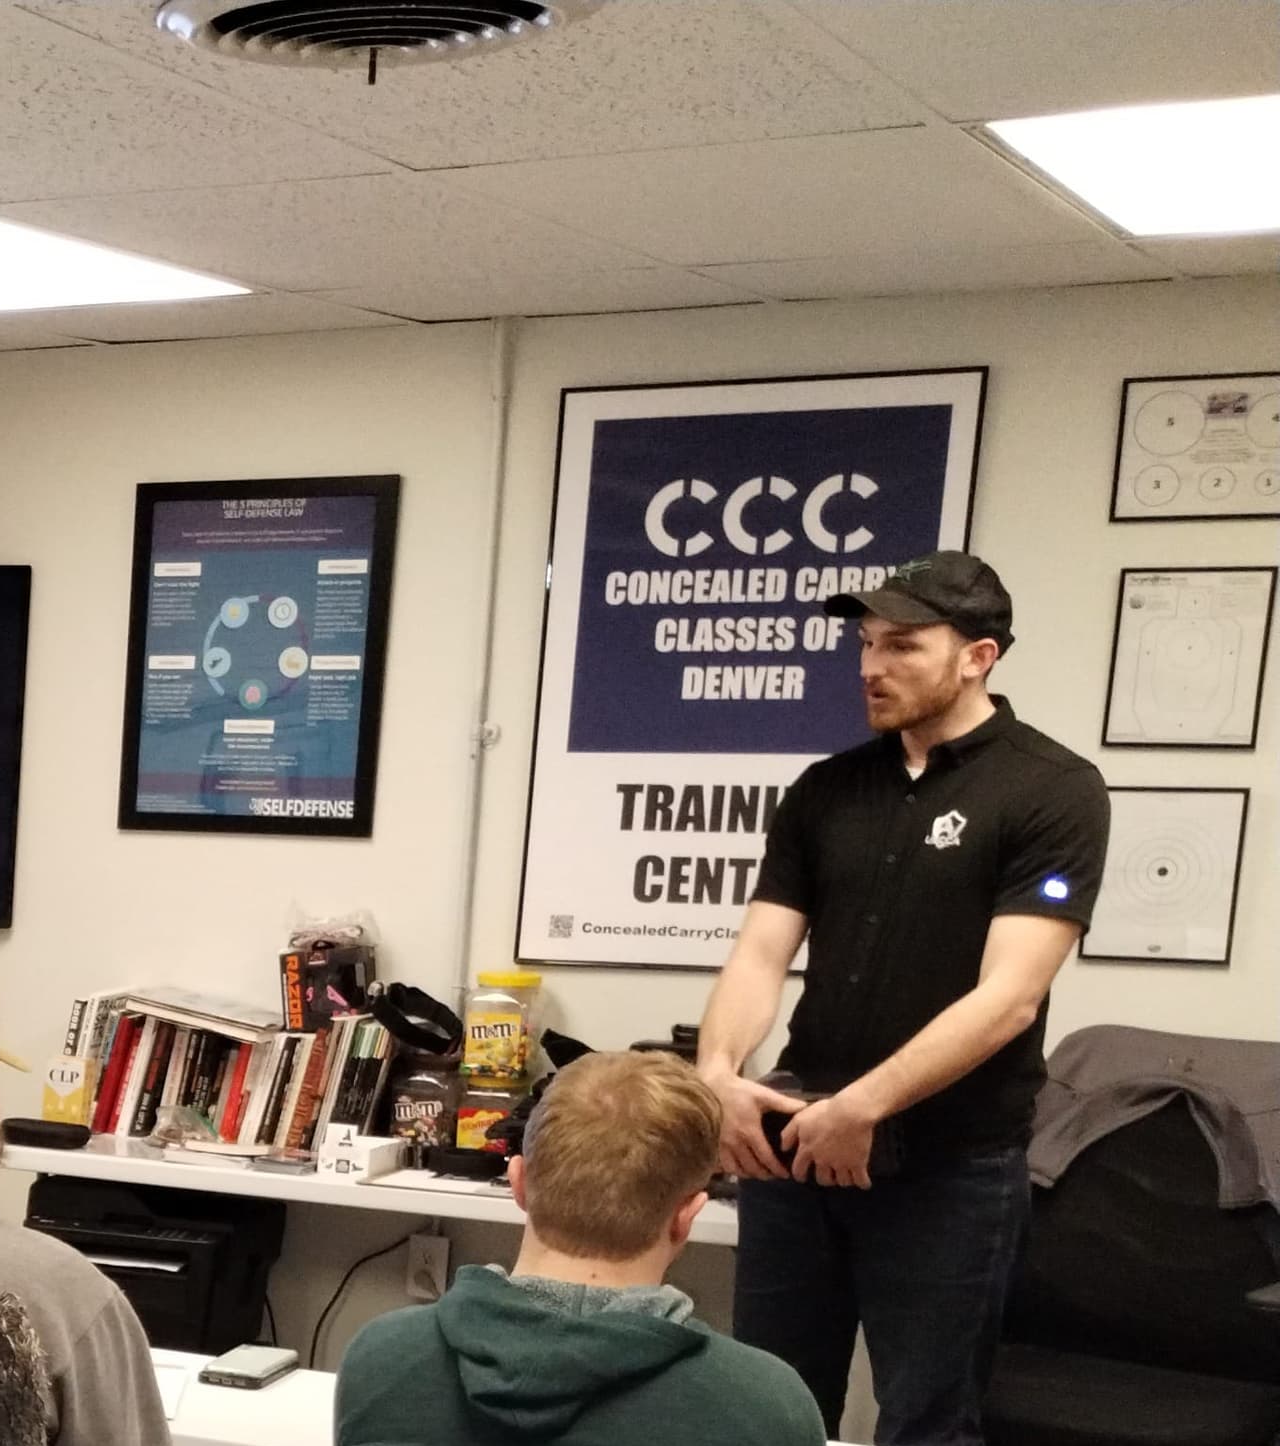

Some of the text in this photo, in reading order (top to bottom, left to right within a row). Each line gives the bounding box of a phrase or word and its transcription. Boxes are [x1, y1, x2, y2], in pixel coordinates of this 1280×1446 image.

[644, 473, 880, 557] CCC
[605, 566, 897, 605] CONCEALED CARR
[655, 617, 845, 653] CLASSES OF
[681, 666, 805, 700] DENVER
[616, 784, 790, 833] TRAINI
[633, 855, 757, 905] CENT
[582, 922, 740, 941] ConcealedCarryCla
[286, 955, 304, 1029] RAZOR
[49, 1069, 80, 1083] CLP
